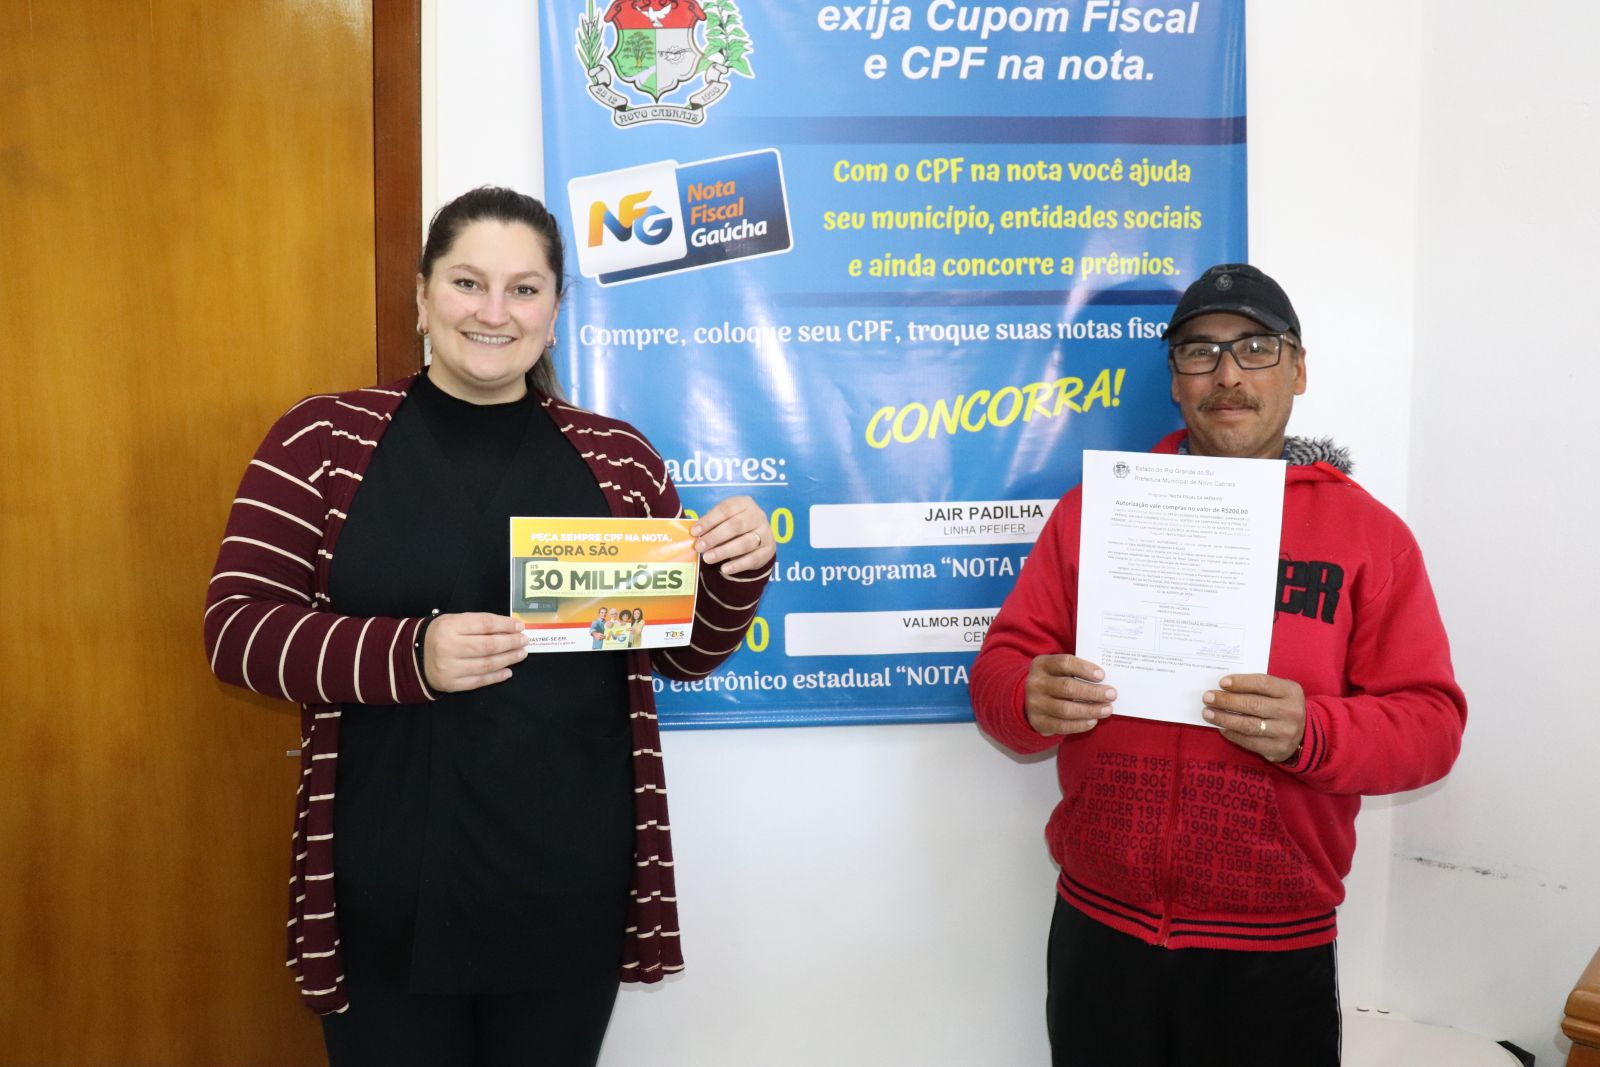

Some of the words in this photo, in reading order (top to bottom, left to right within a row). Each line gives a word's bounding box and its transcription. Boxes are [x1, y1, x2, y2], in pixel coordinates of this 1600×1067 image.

[818, 0, 910, 39] exija
[927, 0, 1069, 39] Cupom
[1083, 0, 1198, 34] Fiscal
[864, 53, 887, 79] e
[902, 46, 987, 80] CPF
[998, 54, 1044, 80] na
[1058, 48, 1154, 80] nota.
[618, 110, 648, 123] NOVO
[833, 160, 888, 182] Com
[895, 164, 909, 181] o
[916, 157, 964, 183] CPF
[971, 163, 999, 182] na
[1007, 161, 1062, 182] nota
[1068, 158, 1123, 181] você
[1129, 159, 1191, 186] ajuda
[688, 180, 736, 203] Nota
[690, 197, 744, 225] Fiscal
[823, 210, 865, 230] seu
[872, 205, 995, 235] município,
[1000, 206, 1117, 229] entidades
[1124, 205, 1202, 230] sociais
[691, 219, 767, 248] Gaúcha
[848, 259, 862, 276] e
[869, 253, 935, 277] ainda
[943, 258, 1054, 277] concorre
[1060, 258, 1074, 276] a
[1082, 252, 1180, 281] prêmios.
[580, 324, 686, 350] Compre,
[694, 322, 792, 347] coloque
[798, 325, 841, 342] seu
[847, 319, 900, 344] CPF,
[908, 320, 989, 346] troque
[996, 323, 1051, 339] suas
[1058, 321, 1122, 339] notas
[865, 368, 1126, 448] CONCORRA!
[925, 507, 963, 521] JAIR
[969, 505, 1044, 520] PADILHA
[1115, 500, 1149, 508] Autorização
[531, 533, 559, 542] PEÇA
[560, 533, 601, 542] SEMPRE
[603, 533, 623, 542] CPF
[624, 533, 640, 541] NA
[641, 533, 673, 542] NOTA.
[943, 526, 976, 535] LINHA
[980, 524, 1025, 534] PFEIFER
[532, 545, 585, 556] AGORA
[589, 543, 619, 556] SÃO
[529, 569, 564, 590] 30
[570, 564, 683, 590] MILHÕES
[787, 561, 816, 581] do
[821, 562, 936, 586] programa
[903, 616, 959, 628] VALMOR
[793, 668, 891, 690] estadual
